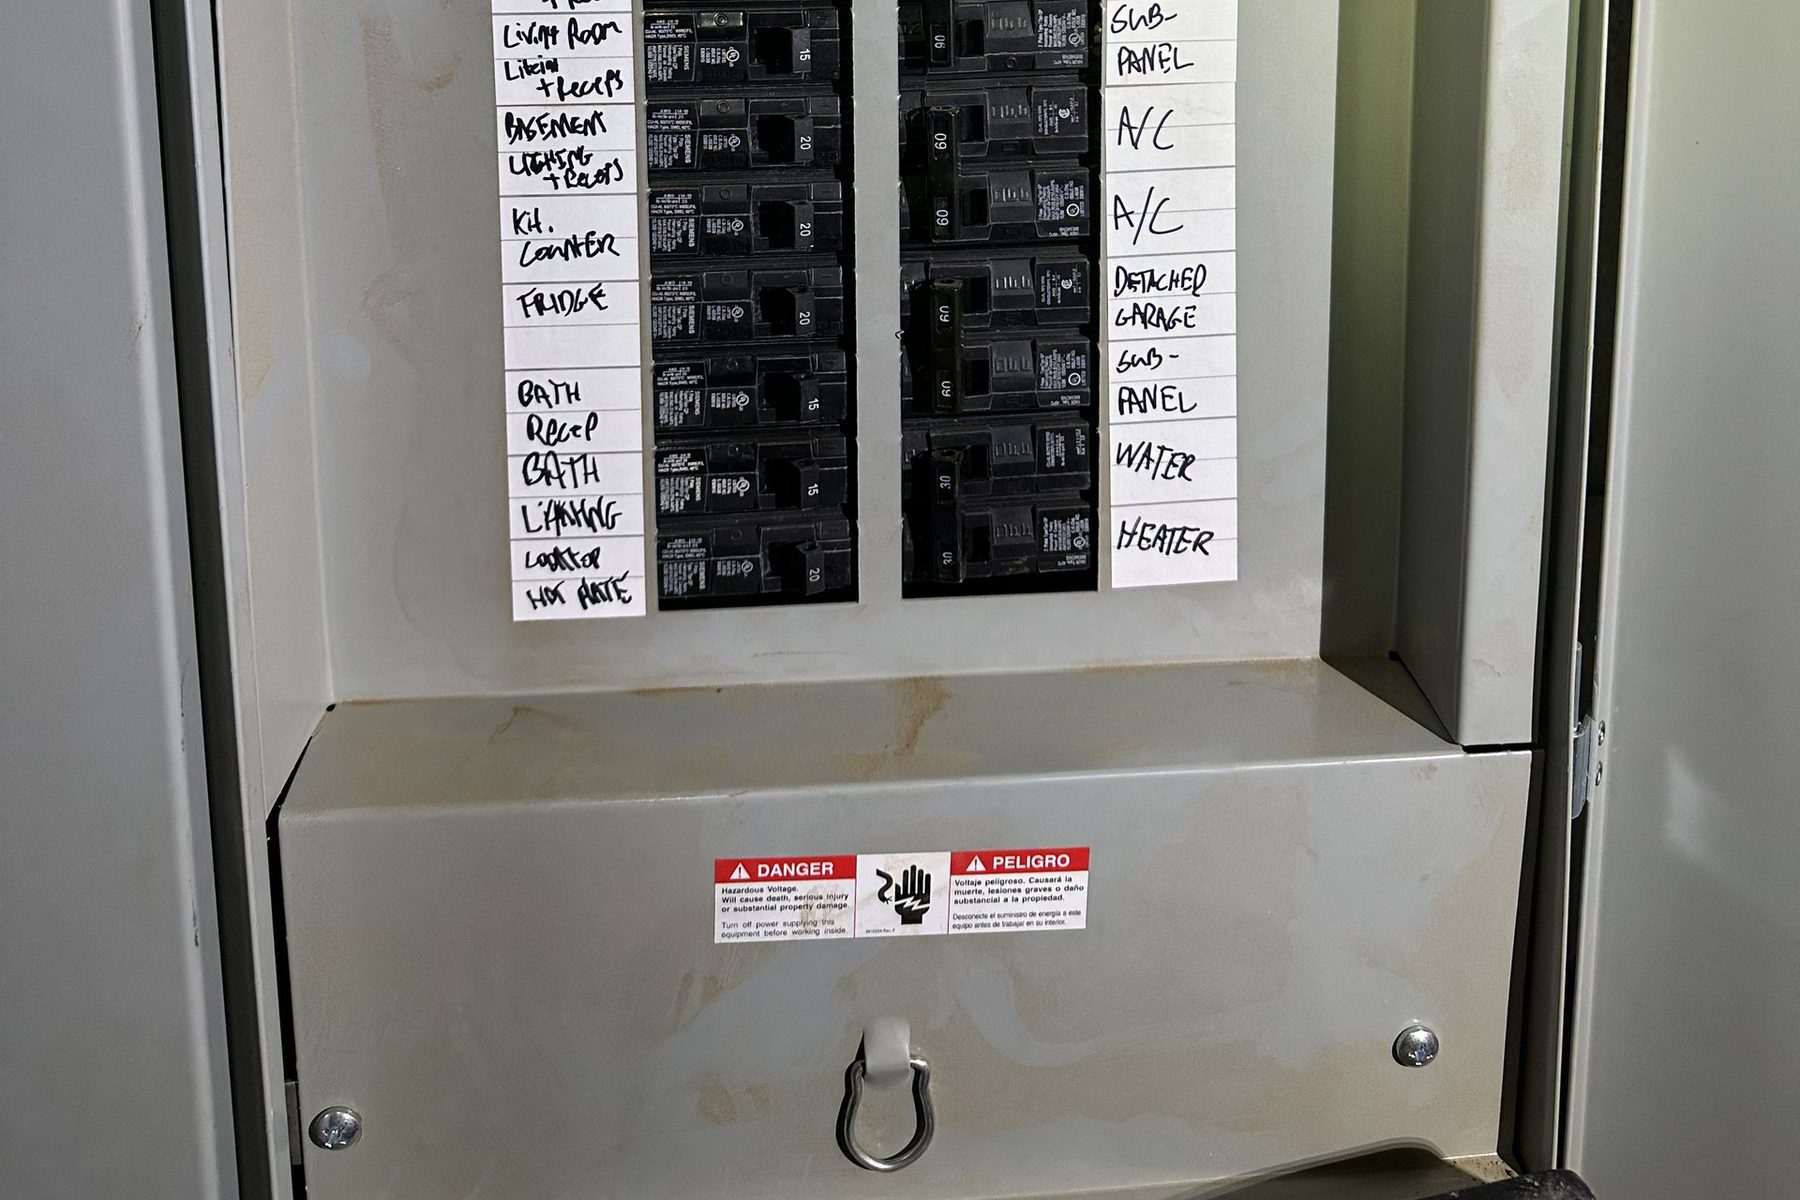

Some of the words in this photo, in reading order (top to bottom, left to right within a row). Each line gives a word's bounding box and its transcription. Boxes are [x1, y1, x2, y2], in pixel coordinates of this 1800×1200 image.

[800, 49, 811, 61] 15
[1117, 43, 1194, 76] PANEL
[1117, 106, 1174, 150] A/C
[800, 136, 812, 150] 20
[934, 133, 947, 149] 60
[936, 209, 949, 226] 60
[1114, 186, 1184, 246] A/C
[799, 223, 811, 237] 20
[1114, 264, 1207, 297] DETACHED
[799, 311, 811, 325] 20
[1115, 303, 1196, 331] GARAGE
[518, 379, 581, 409] BATH
[1118, 384, 1197, 416] PANEL
[808, 398, 820, 411] 15
[1115, 441, 1196, 481] WATER
[522, 450, 600, 489] BATH
[940, 475, 952, 489] 30
[808, 483, 819, 496] 15
[1116, 516, 1214, 556] HEATER
[943, 552, 953, 565] 30
[809, 568, 820, 582] 20
[993, 854, 1070, 870] PELIGRO
[757, 862, 834, 877] DANGER
[955, 879, 982, 888] Voltaje
[985, 878, 1026, 887] peligroso.
[1029, 875, 1062, 883] Causará
[766, 894, 791, 902] death,
[826, 892, 849, 902] injury
[767, 885, 799, 895] Voltage.
[954, 888, 985, 896] muerte,
[988, 886, 1022, 894] lesiones
[1025, 886, 1052, 894] graves
[1064, 884, 1085, 892] daño
[954, 896, 1000, 905] substancial
[1022, 894, 1065, 904] propiedad.
[733, 904, 777, 912] substantial
[780, 903, 814, 913] property
[816, 902, 849, 911] damage.
[997, 911, 1027, 919] suministro
[722, 921, 738, 929] Turn
[755, 921, 779, 929] power
[783, 919, 818, 928] supplying
[821, 918, 835, 926] this
[952, 921, 973, 930] equipo
[721, 930, 760, 939] equipment
[764, 929, 788, 937] before
[792, 928, 820, 937] working
[824, 927, 848, 935] inside.
